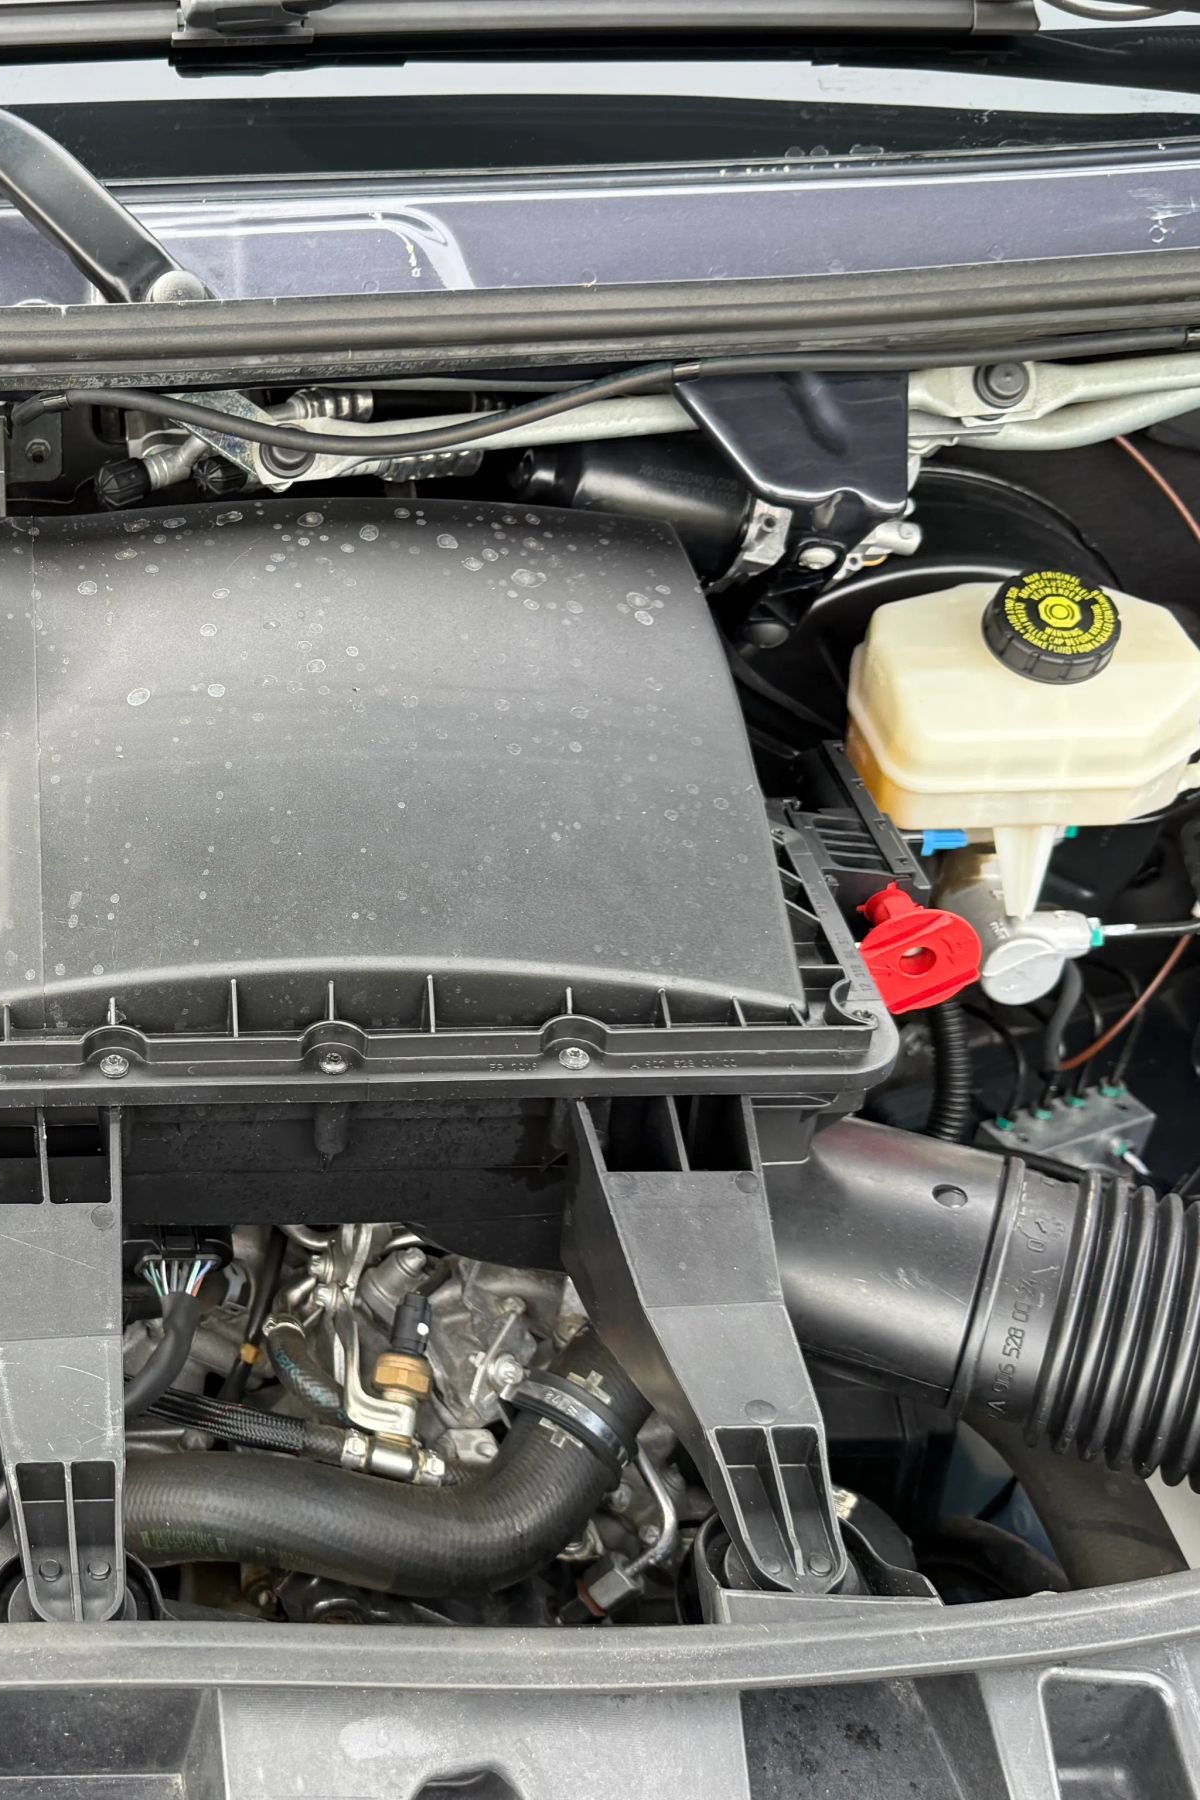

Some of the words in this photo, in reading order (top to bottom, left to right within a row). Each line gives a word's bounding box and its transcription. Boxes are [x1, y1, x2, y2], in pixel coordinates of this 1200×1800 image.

[1041, 571, 1081, 585] ORIGINAL
[1048, 635, 1065, 645] CAP
[1000, 1325, 1027, 1361] 528
